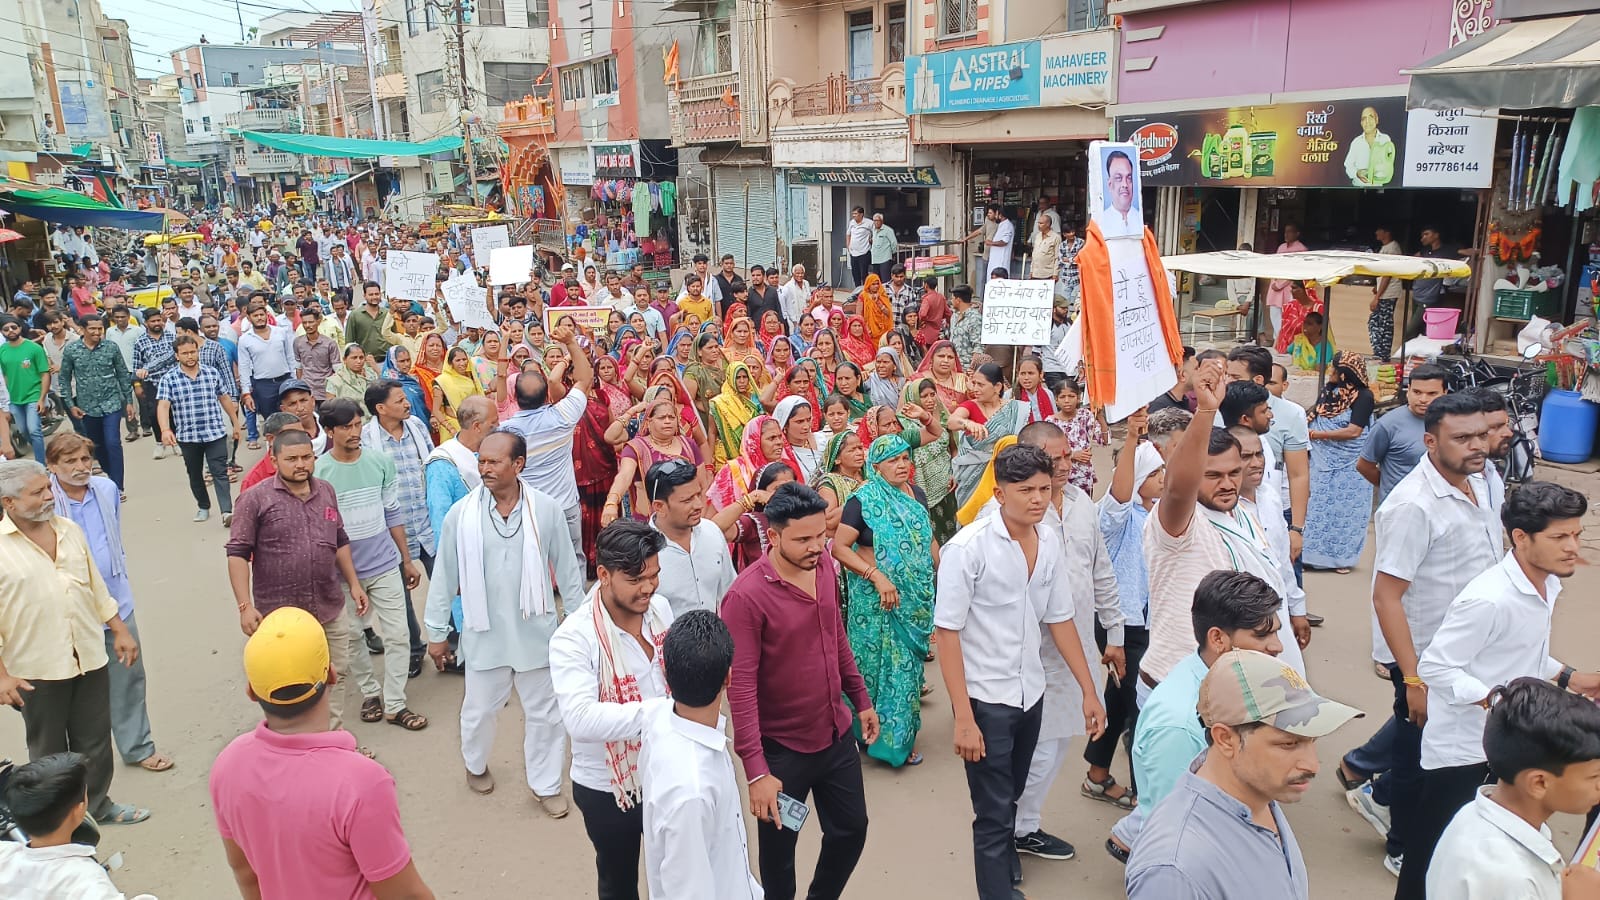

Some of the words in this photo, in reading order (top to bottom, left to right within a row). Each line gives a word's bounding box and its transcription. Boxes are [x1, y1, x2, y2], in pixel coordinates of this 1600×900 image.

[968, 47, 1031, 75] ASTRAL
[1045, 51, 1107, 69] MAHAVEER
[973, 74, 1011, 92] PIPES
[1043, 70, 1109, 88] MACHINERY
[1427, 123, 1470, 137] किराना
[1134, 131, 1174, 148] Madhuri
[1427, 141, 1466, 155] महेश्वर
[1416, 161, 1479, 172] 9977786144
[816, 168, 867, 183] गणगौर
